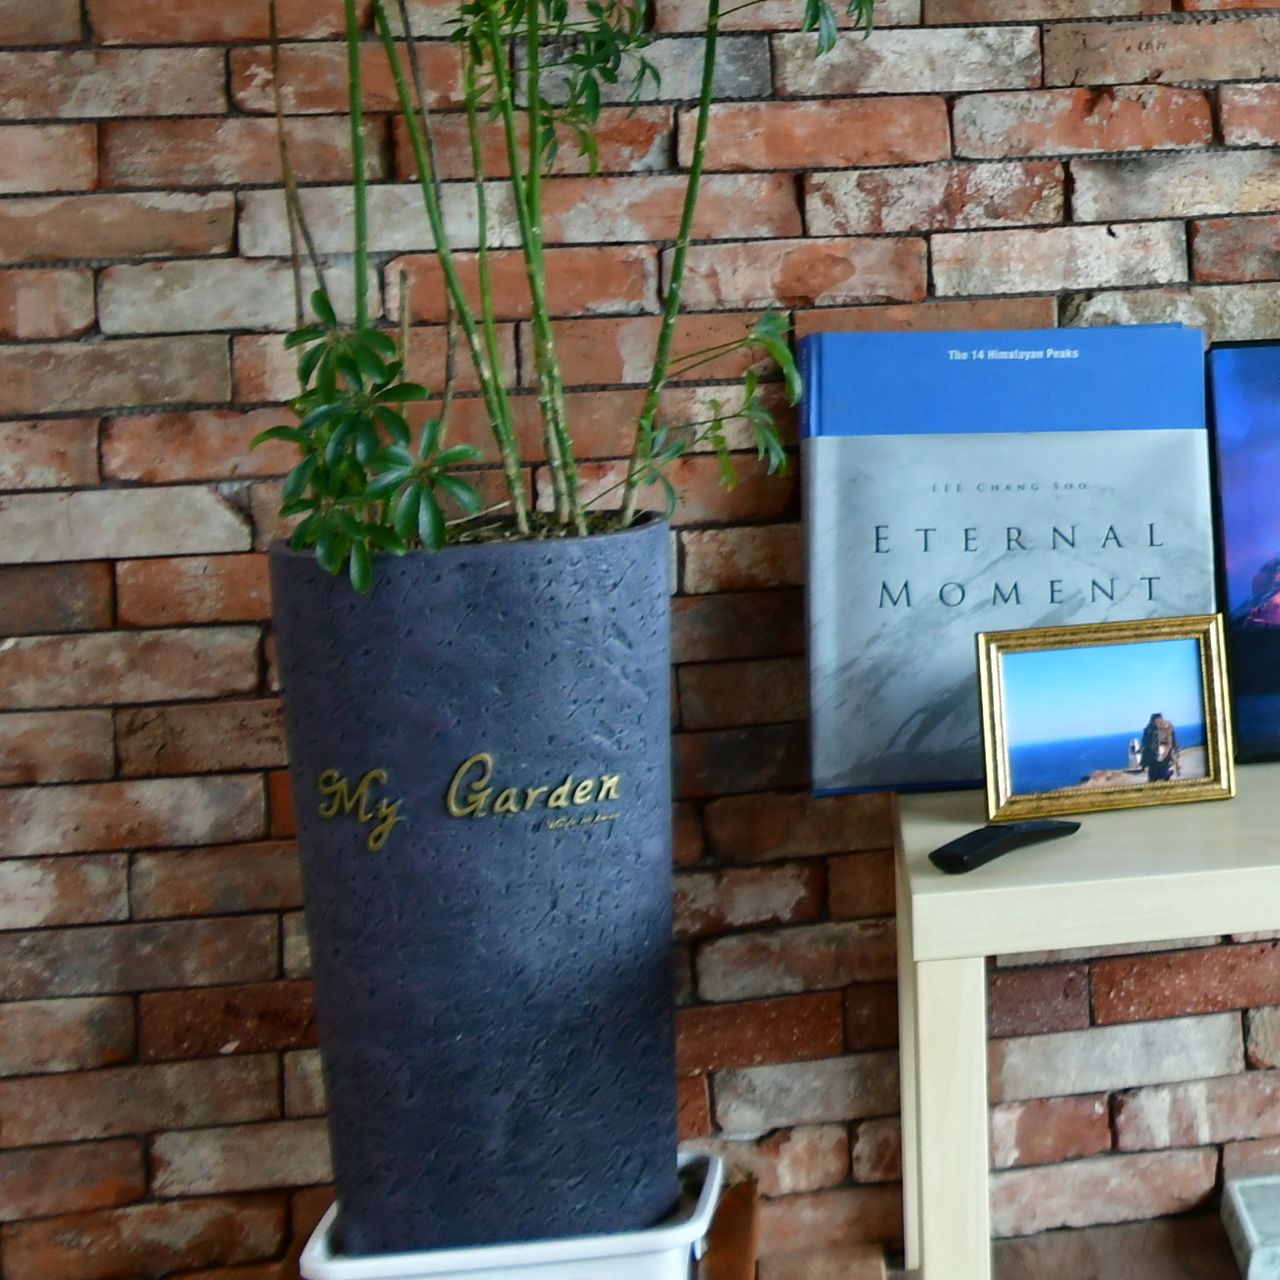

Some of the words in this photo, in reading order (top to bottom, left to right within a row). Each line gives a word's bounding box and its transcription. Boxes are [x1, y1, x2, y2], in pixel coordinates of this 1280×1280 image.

[948, 349, 968, 361] The
[971, 350, 985, 360] 14
[987, 349, 1044, 361] Himalayan
[1046, 348, 1079, 360] Peaks
[931, 482, 962, 493] LEE
[873, 522, 1164, 554] ETERNAL
[878, 575, 1161, 609] MOMENT
[318, 768, 403, 851] My
[446, 752, 623, 818] Garden
